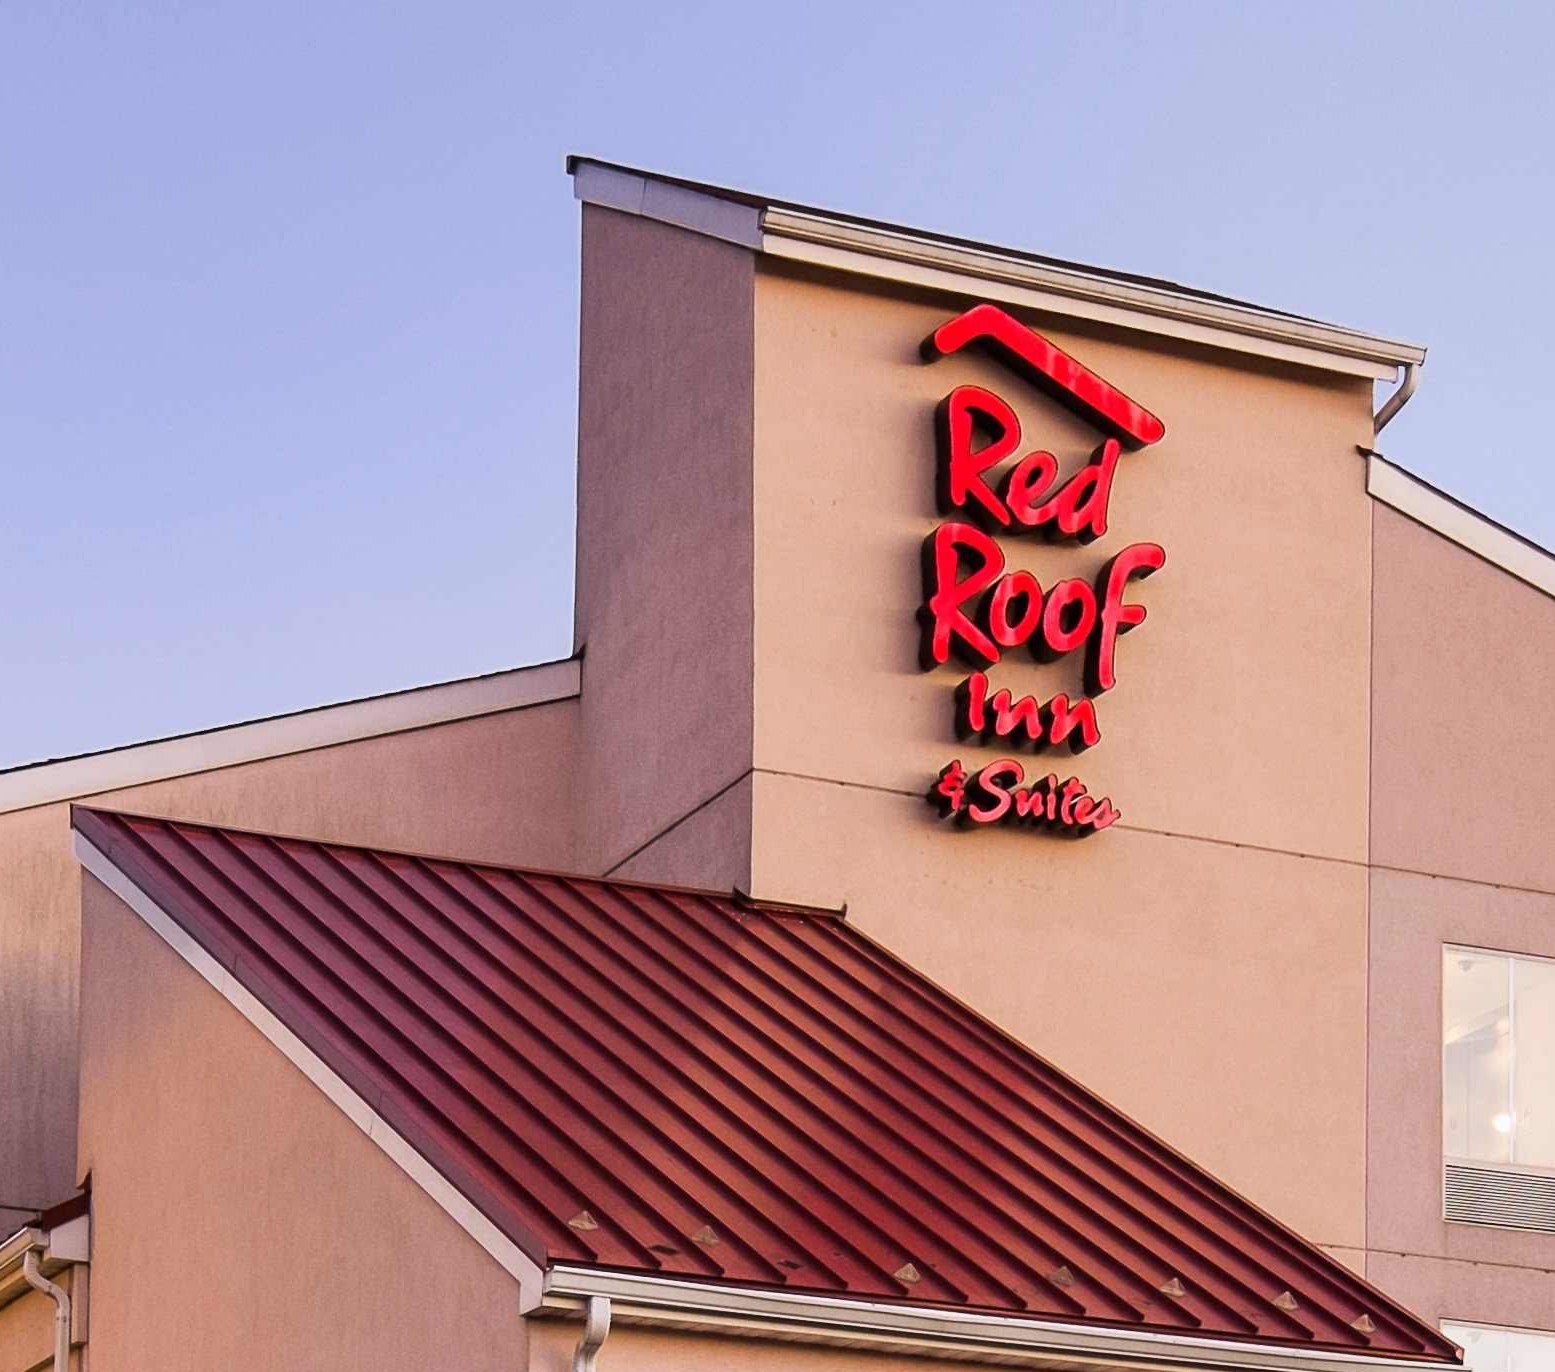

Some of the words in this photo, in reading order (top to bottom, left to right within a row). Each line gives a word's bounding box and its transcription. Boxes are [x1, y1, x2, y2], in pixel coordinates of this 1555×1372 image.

[948, 385, 1121, 537] Red
[928, 521, 1166, 690] Roof
[966, 671, 1102, 747] Inn
[967, 758, 1121, 831] Suites
